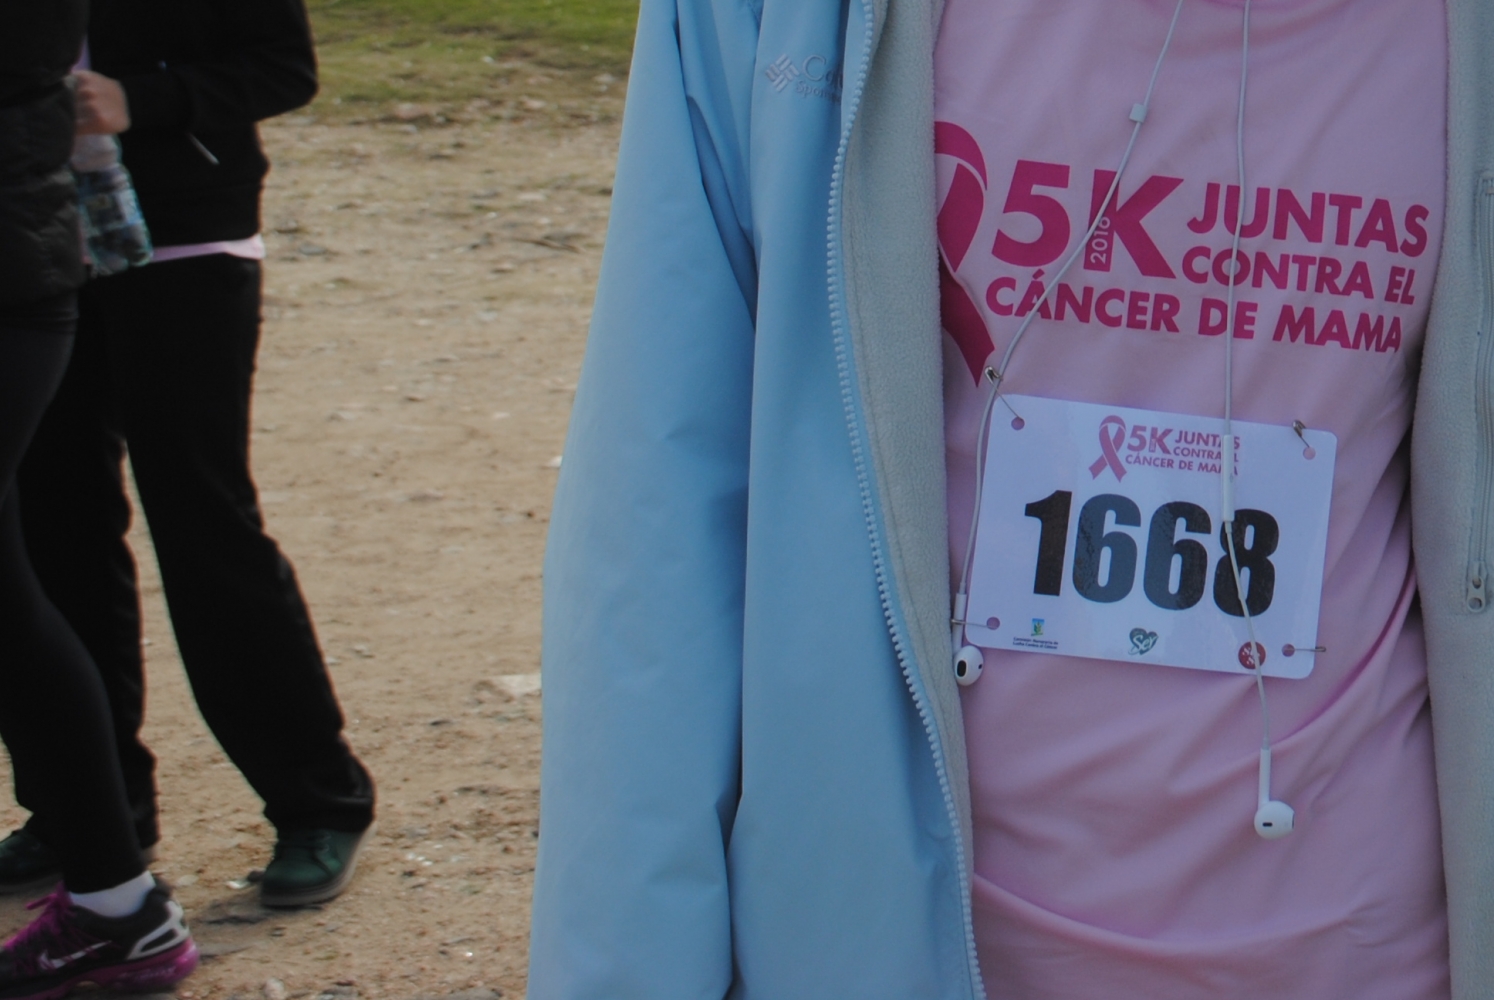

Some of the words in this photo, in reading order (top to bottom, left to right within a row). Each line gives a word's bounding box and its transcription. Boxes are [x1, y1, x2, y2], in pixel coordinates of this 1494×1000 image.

[991, 159, 1185, 280] 5K
[1090, 216, 1111, 265] 2016
[1186, 182, 1430, 258] JUNTAS
[1181, 246, 1375, 300] CONTRA
[1384, 266, 1416, 306] EL
[985, 269, 1181, 333] CÁNCER
[1197, 297, 1258, 341] DE
[1272, 305, 1402, 354] MAMA
[1125, 452, 1175, 469] CÁNCER
[1178, 460, 1194, 471] DE
[1127, 425, 1173, 454] 5K
[1024, 489, 1280, 618] 1668
